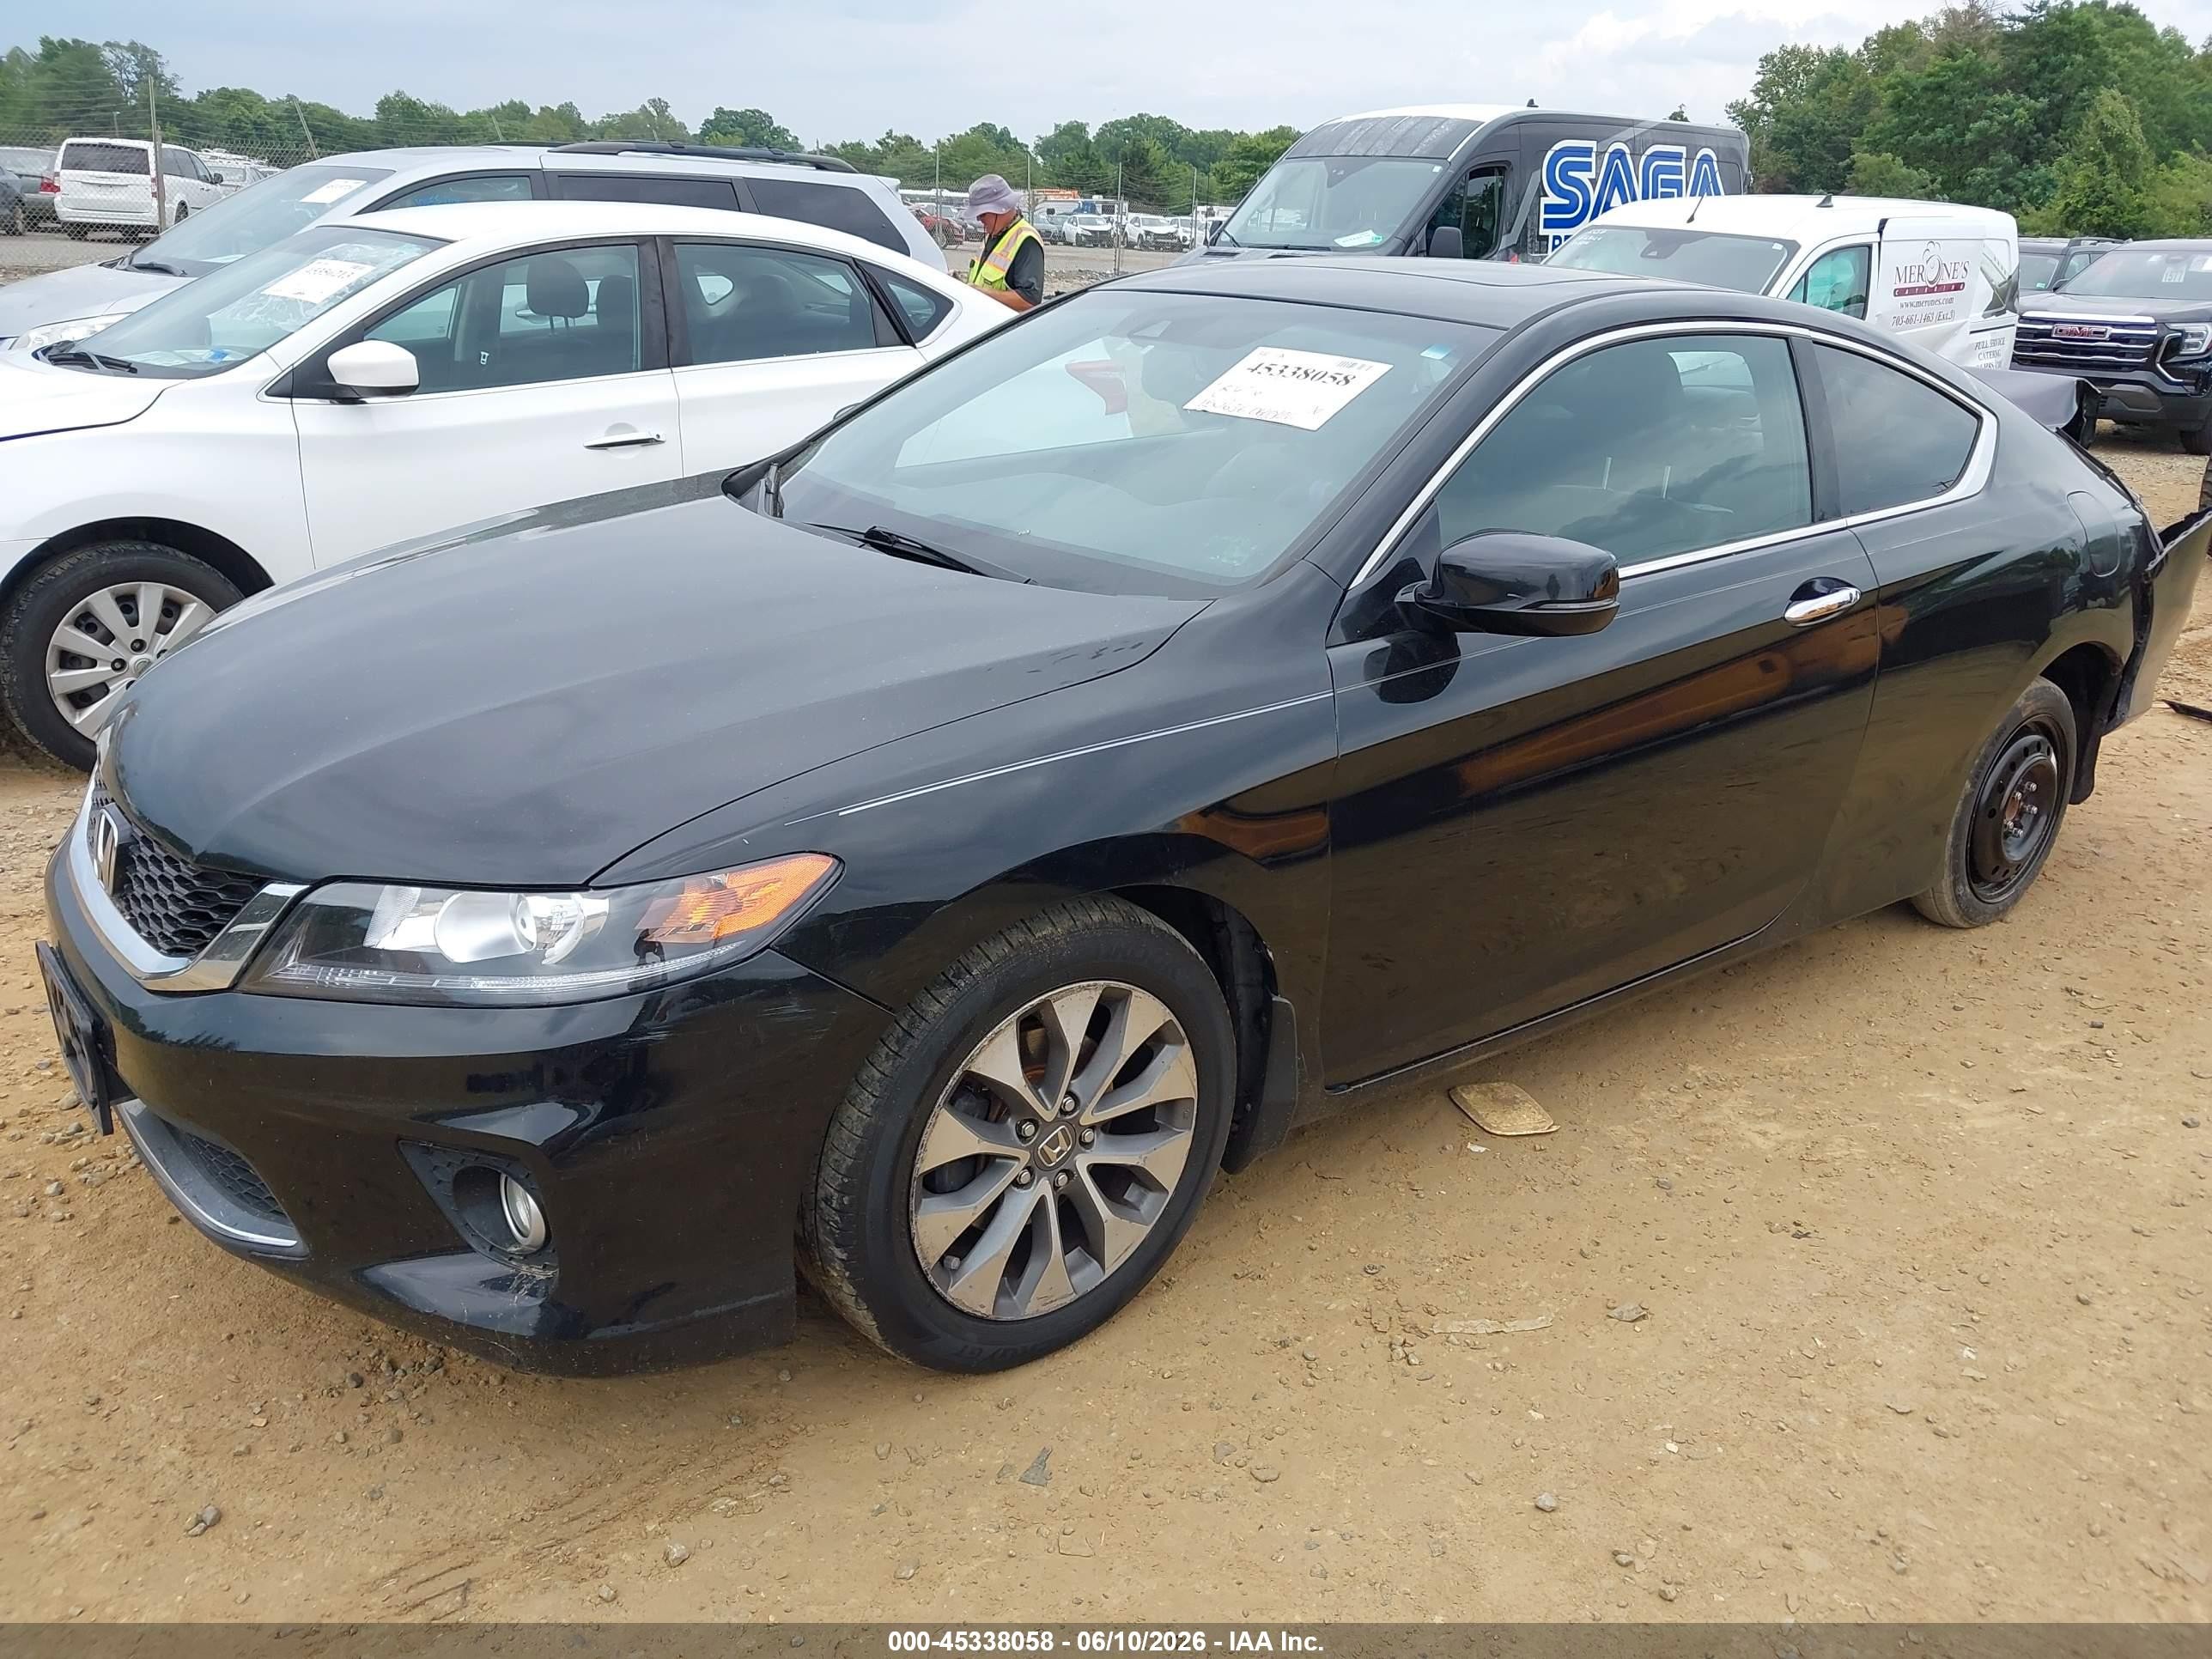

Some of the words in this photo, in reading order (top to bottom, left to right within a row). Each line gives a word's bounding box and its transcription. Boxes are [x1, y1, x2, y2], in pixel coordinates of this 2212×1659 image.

[1540, 139, 1724, 236] SAGA
[1894, 255, 1970, 285] MERONE'S
[2056, 326, 2107, 337] GMC
[1247, 362, 1356, 386] 45338058
